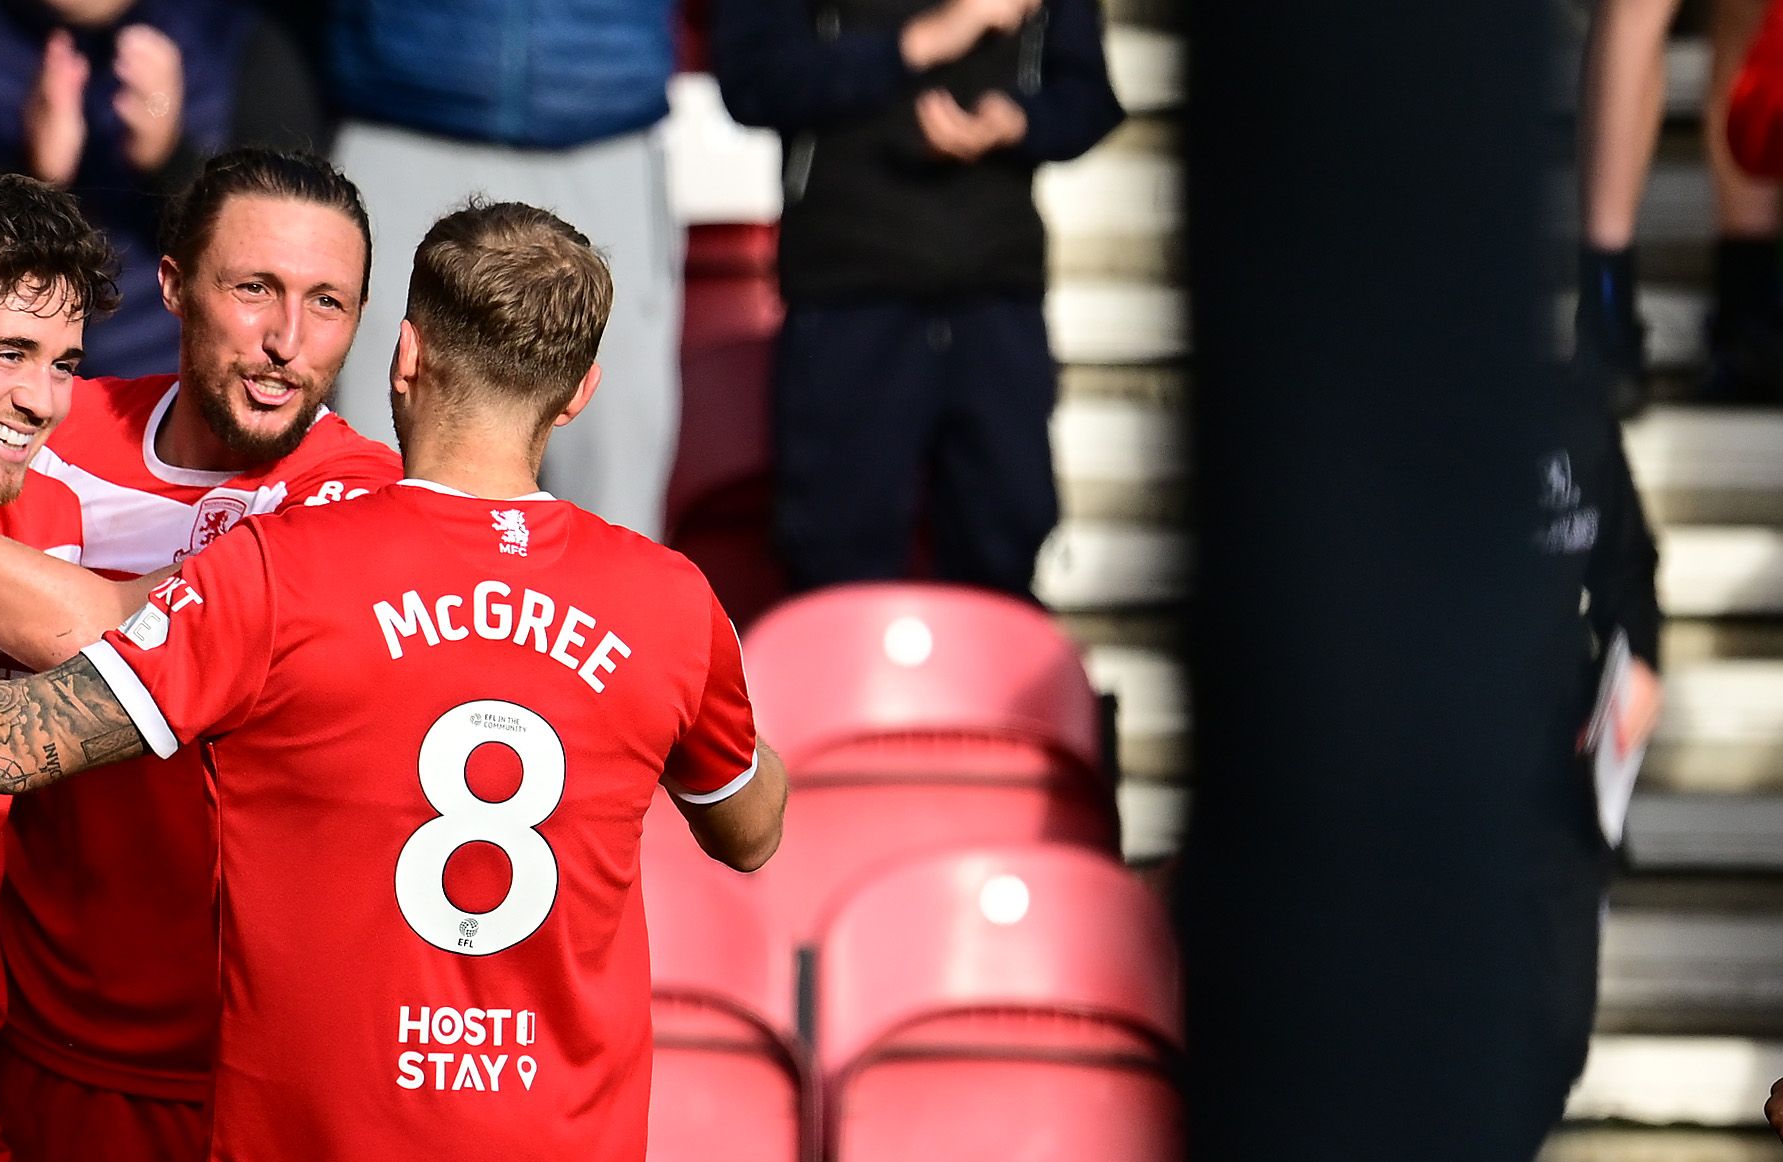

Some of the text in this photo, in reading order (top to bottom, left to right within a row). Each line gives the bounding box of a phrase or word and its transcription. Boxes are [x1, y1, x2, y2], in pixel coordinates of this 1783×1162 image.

[499, 543, 528, 557] MFC
[372, 580, 632, 694] McGREE
[483, 722, 527, 733] COMMUNITY
[394, 698, 567, 957] 8
[457, 938, 475, 949] EFL
[397, 1005, 512, 1047] HOST
[395, 1051, 509, 1092] STAY
